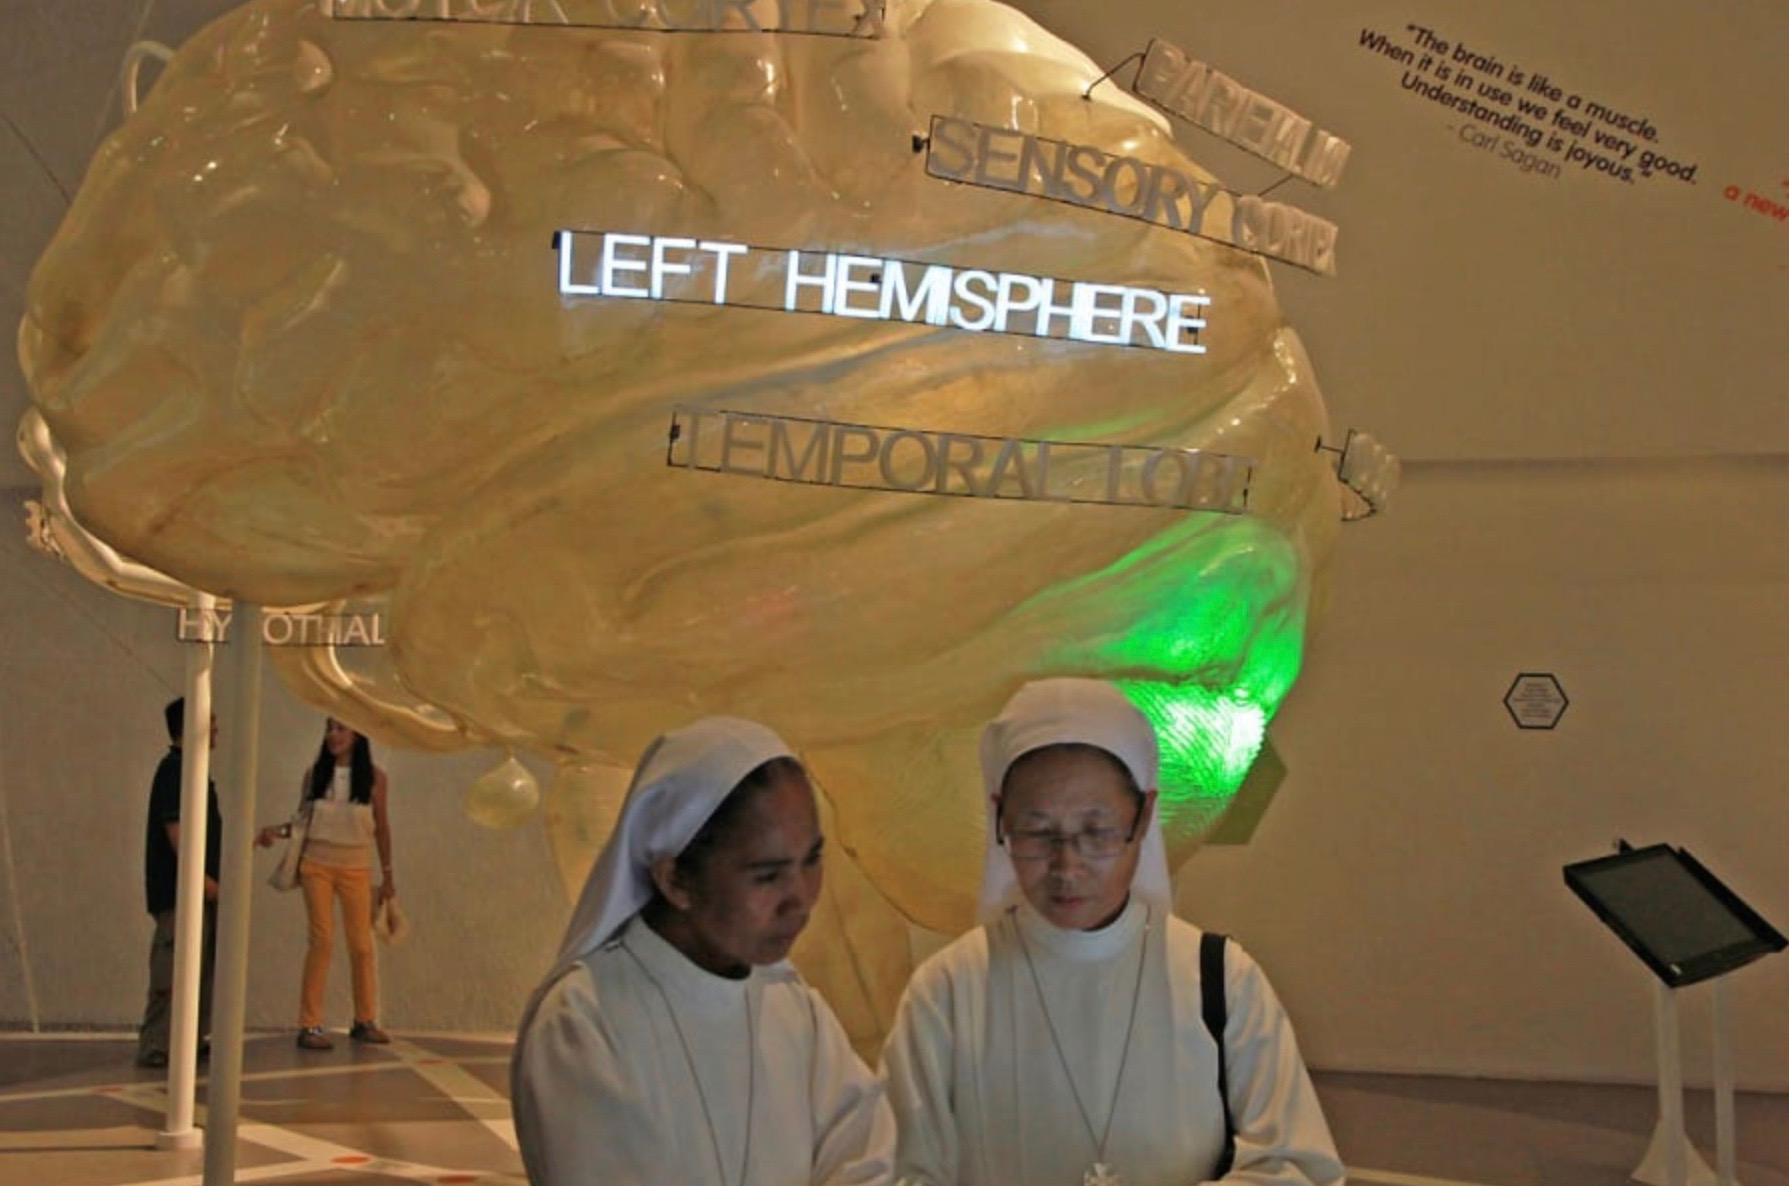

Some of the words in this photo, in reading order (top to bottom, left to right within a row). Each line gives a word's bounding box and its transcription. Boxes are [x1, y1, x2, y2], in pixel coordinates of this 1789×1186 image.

[1359, 28, 1414, 66] When
[1417, 52, 1433, 71] it
[1434, 60, 1452, 81] is
[1454, 68, 1474, 90] in
[1478, 82, 1513, 106] use
[1518, 97, 1548, 120] we
[1552, 109, 1592, 138] feel
[1594, 129, 1637, 160] very
[1638, 150, 1697, 185] good.
[1401, 71, 1543, 147] Understanding
[1546, 131, 1564, 151] is
[1452, 43, 1504, 78] brain
[1507, 65, 1526, 86] is
[1528, 73, 1562, 102] like
[1567, 94, 1582, 109] a
[1585, 102, 1659, 144] muscle.
[931, 116, 1220, 234] SENSORY
[1459, 123, 1499, 150] Carl
[1499, 140, 1562, 179] Sagan
[1724, 185, 1742, 202] a
[559, 230, 748, 305] LEFT
[785, 250, 1210, 355] HEMISPHERE
[675, 404, 1072, 503] TEMPORAL
